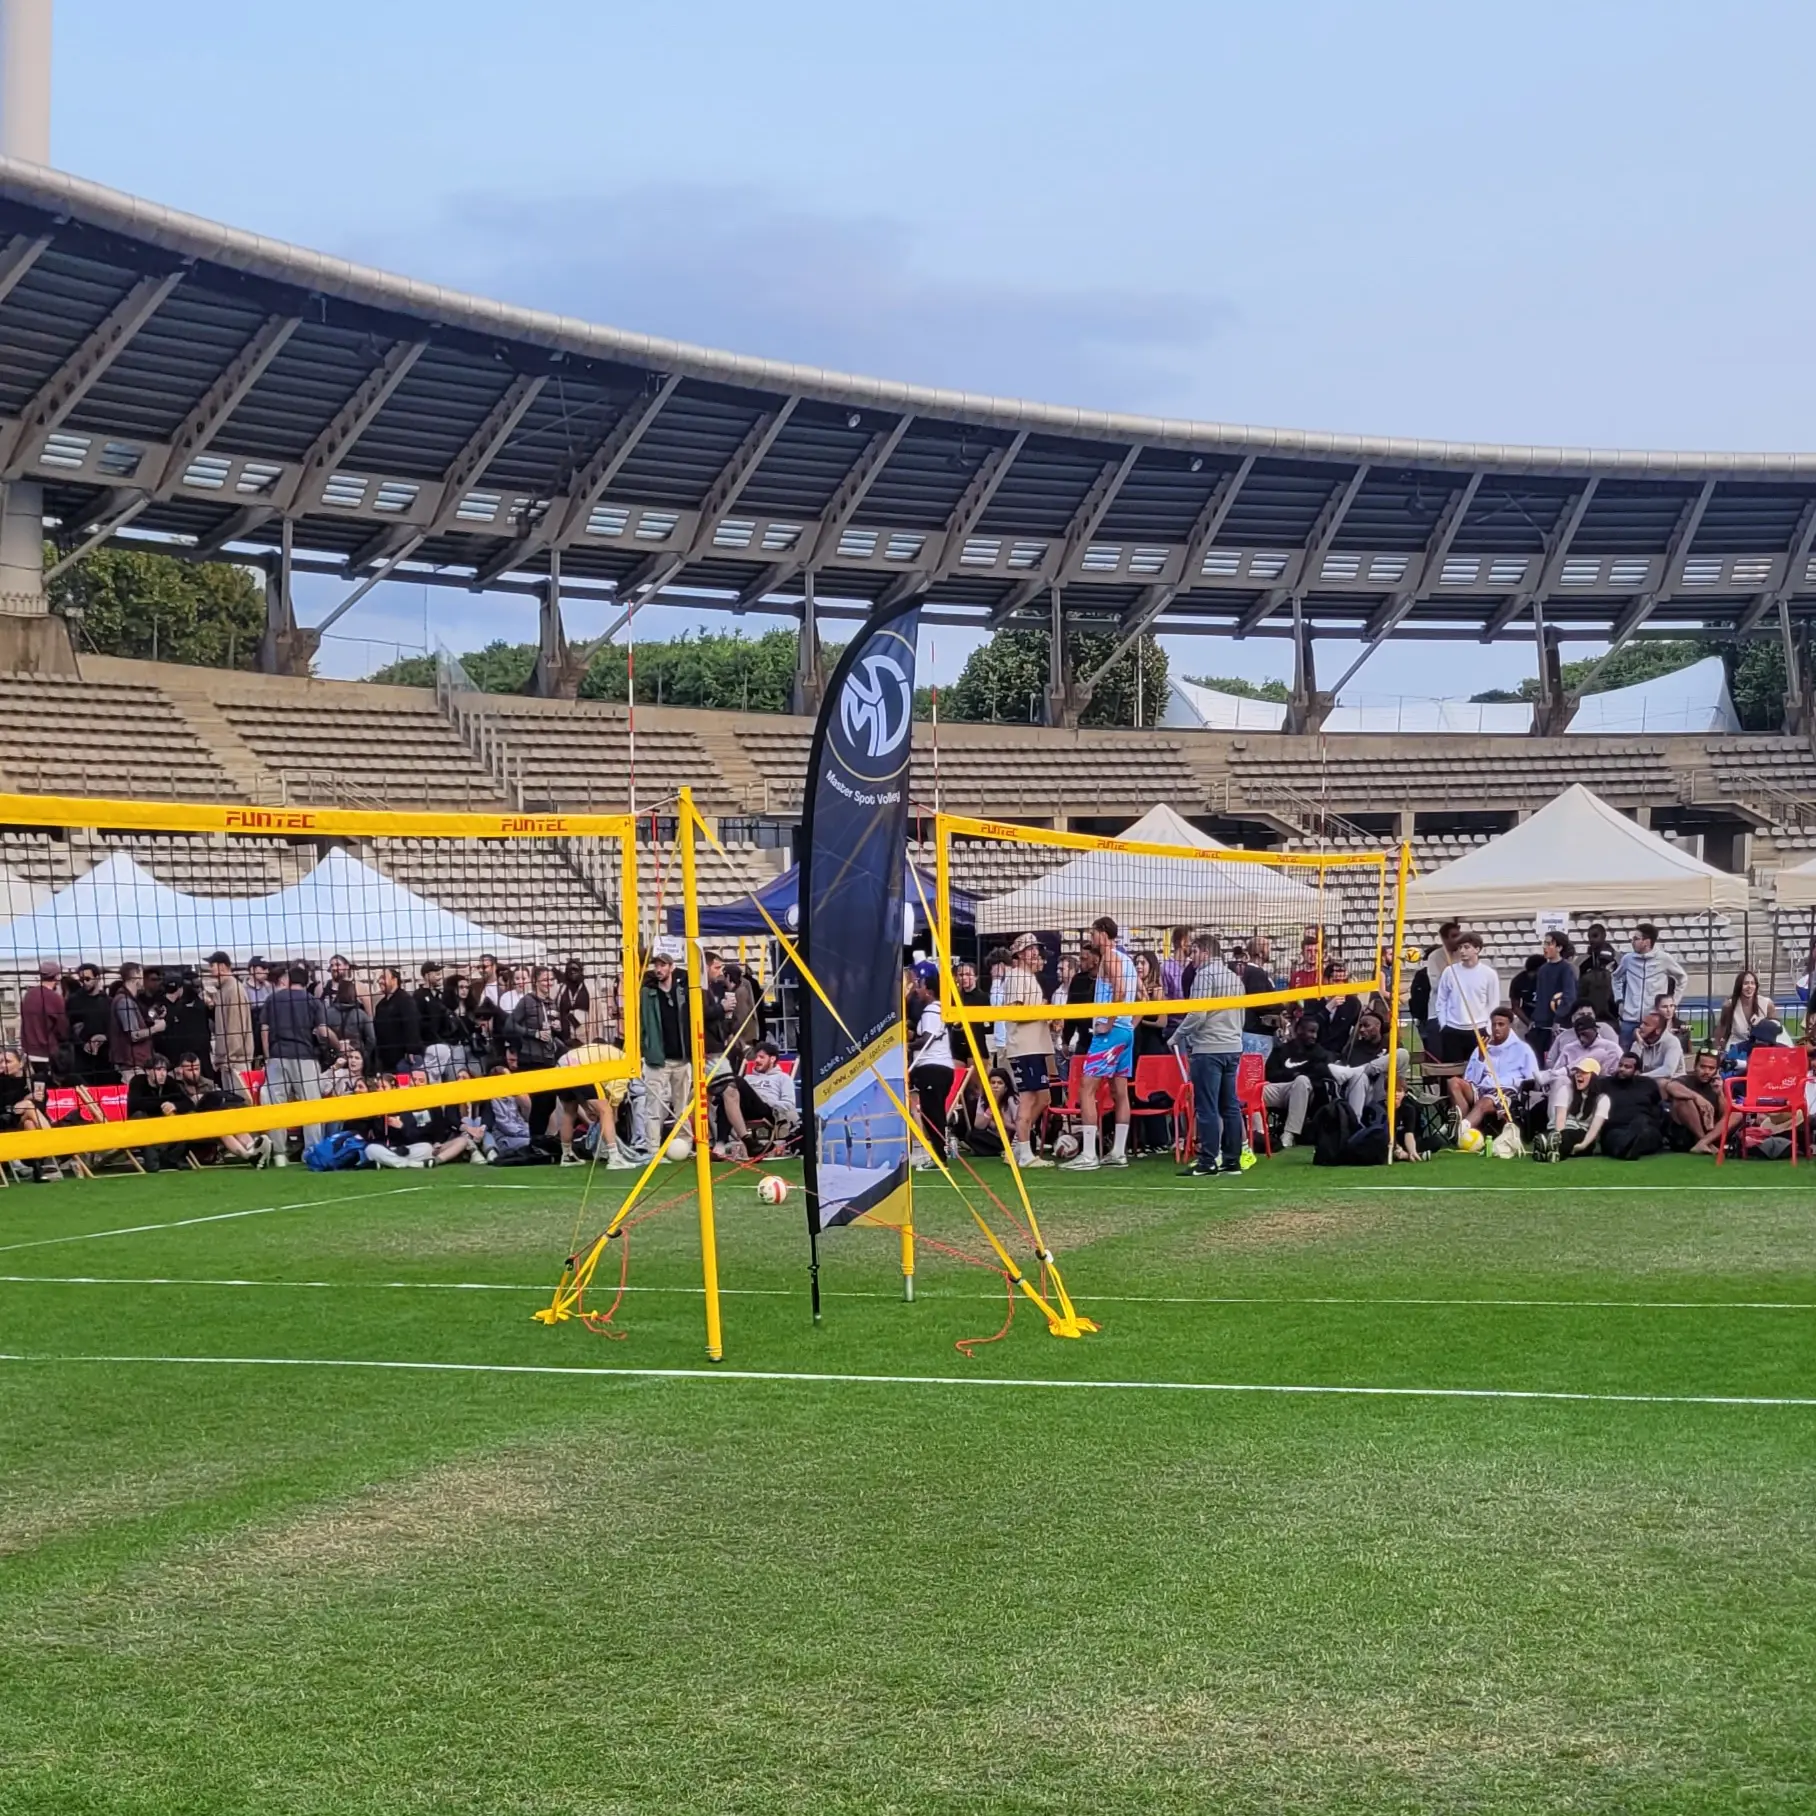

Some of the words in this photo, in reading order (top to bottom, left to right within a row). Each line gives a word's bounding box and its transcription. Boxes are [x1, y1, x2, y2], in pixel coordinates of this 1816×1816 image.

[825, 769, 853, 798] Master
[853, 790, 876, 806] Spot
[876, 791, 901, 805] Volley
[226, 811, 316, 828] FUNTEC
[501, 818, 568, 832] FUNTEC
